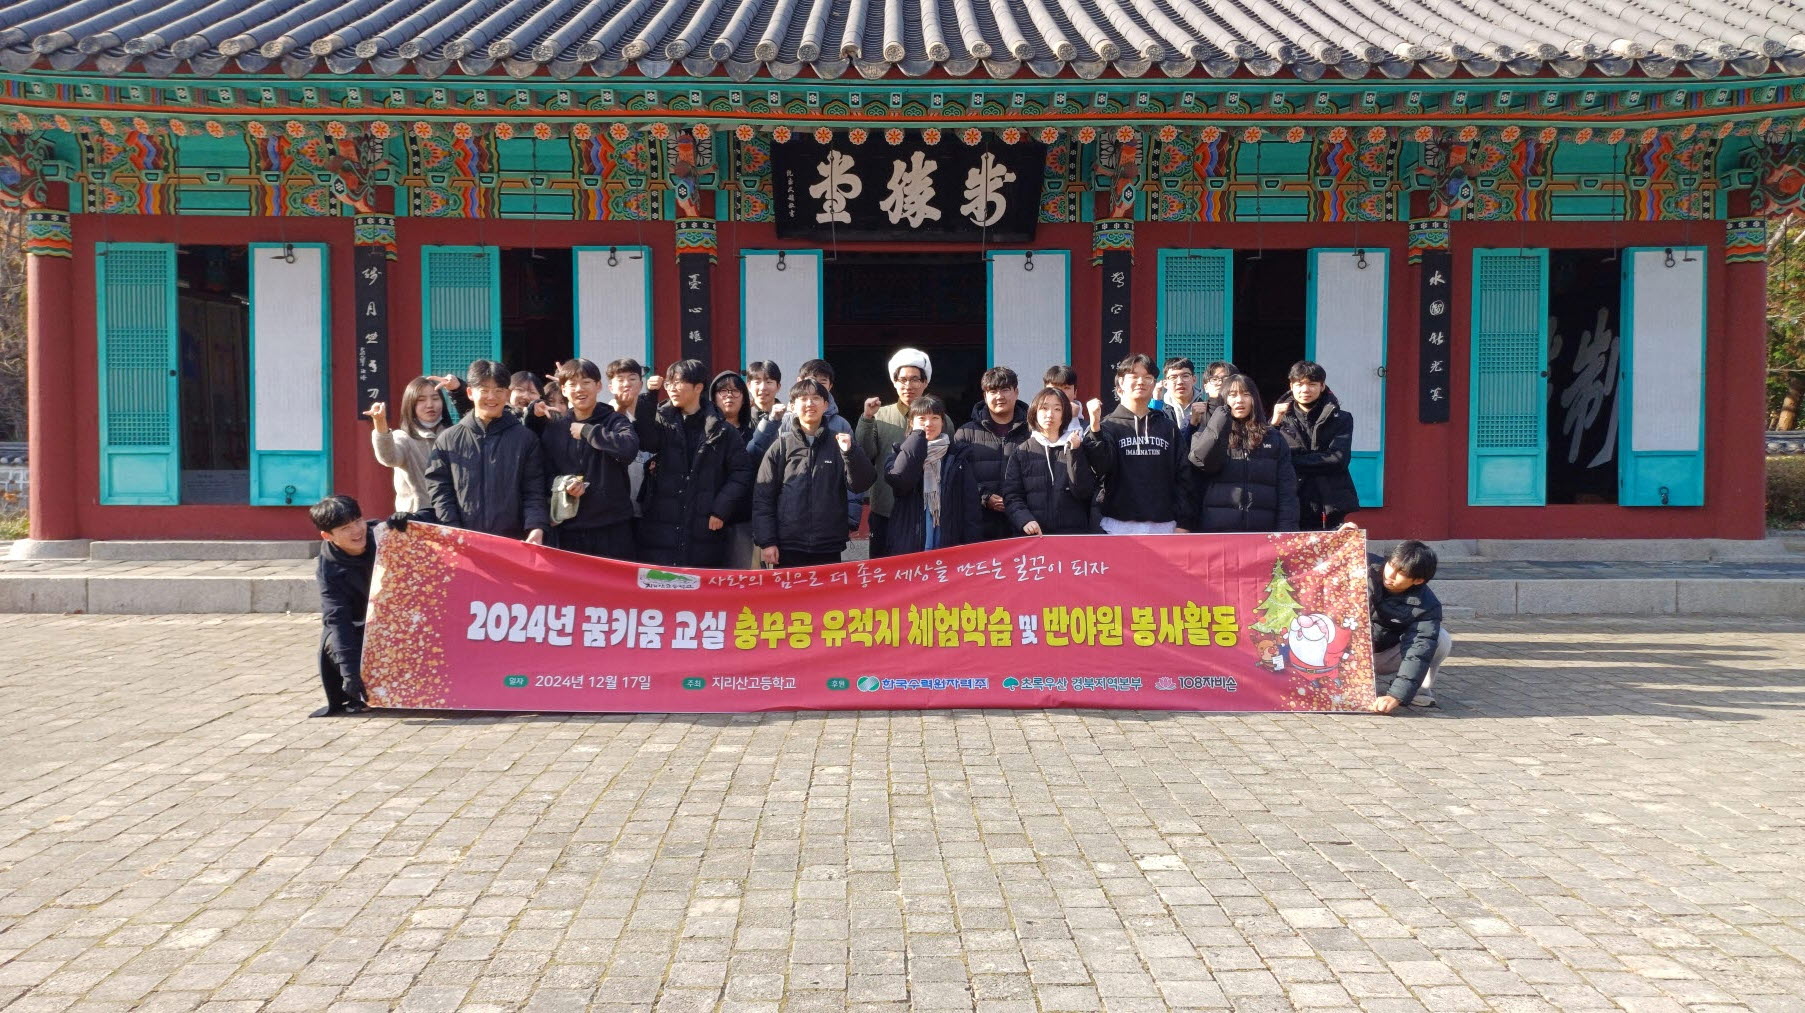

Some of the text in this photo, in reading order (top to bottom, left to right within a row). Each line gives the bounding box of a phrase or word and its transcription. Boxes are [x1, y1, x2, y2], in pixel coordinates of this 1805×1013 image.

[708, 555, 1110, 589] 사랑의 힘으로 더 좋은 세상을 만드는 일꾼이 되자
[467, 600, 1239, 650] 2024년 꿈키움 교실 충무공 유적지 체험학습 및 반야원 봉사활동
[508, 675, 651, 690] 일자 2024년 12월 17일
[687, 676, 796, 691] 주최 지리산고등학교
[831, 679, 846, 688] 후원
[1020, 676, 1142, 692] 초록우산 경북지역본부
[1178, 676, 1238, 692] 108자비손
